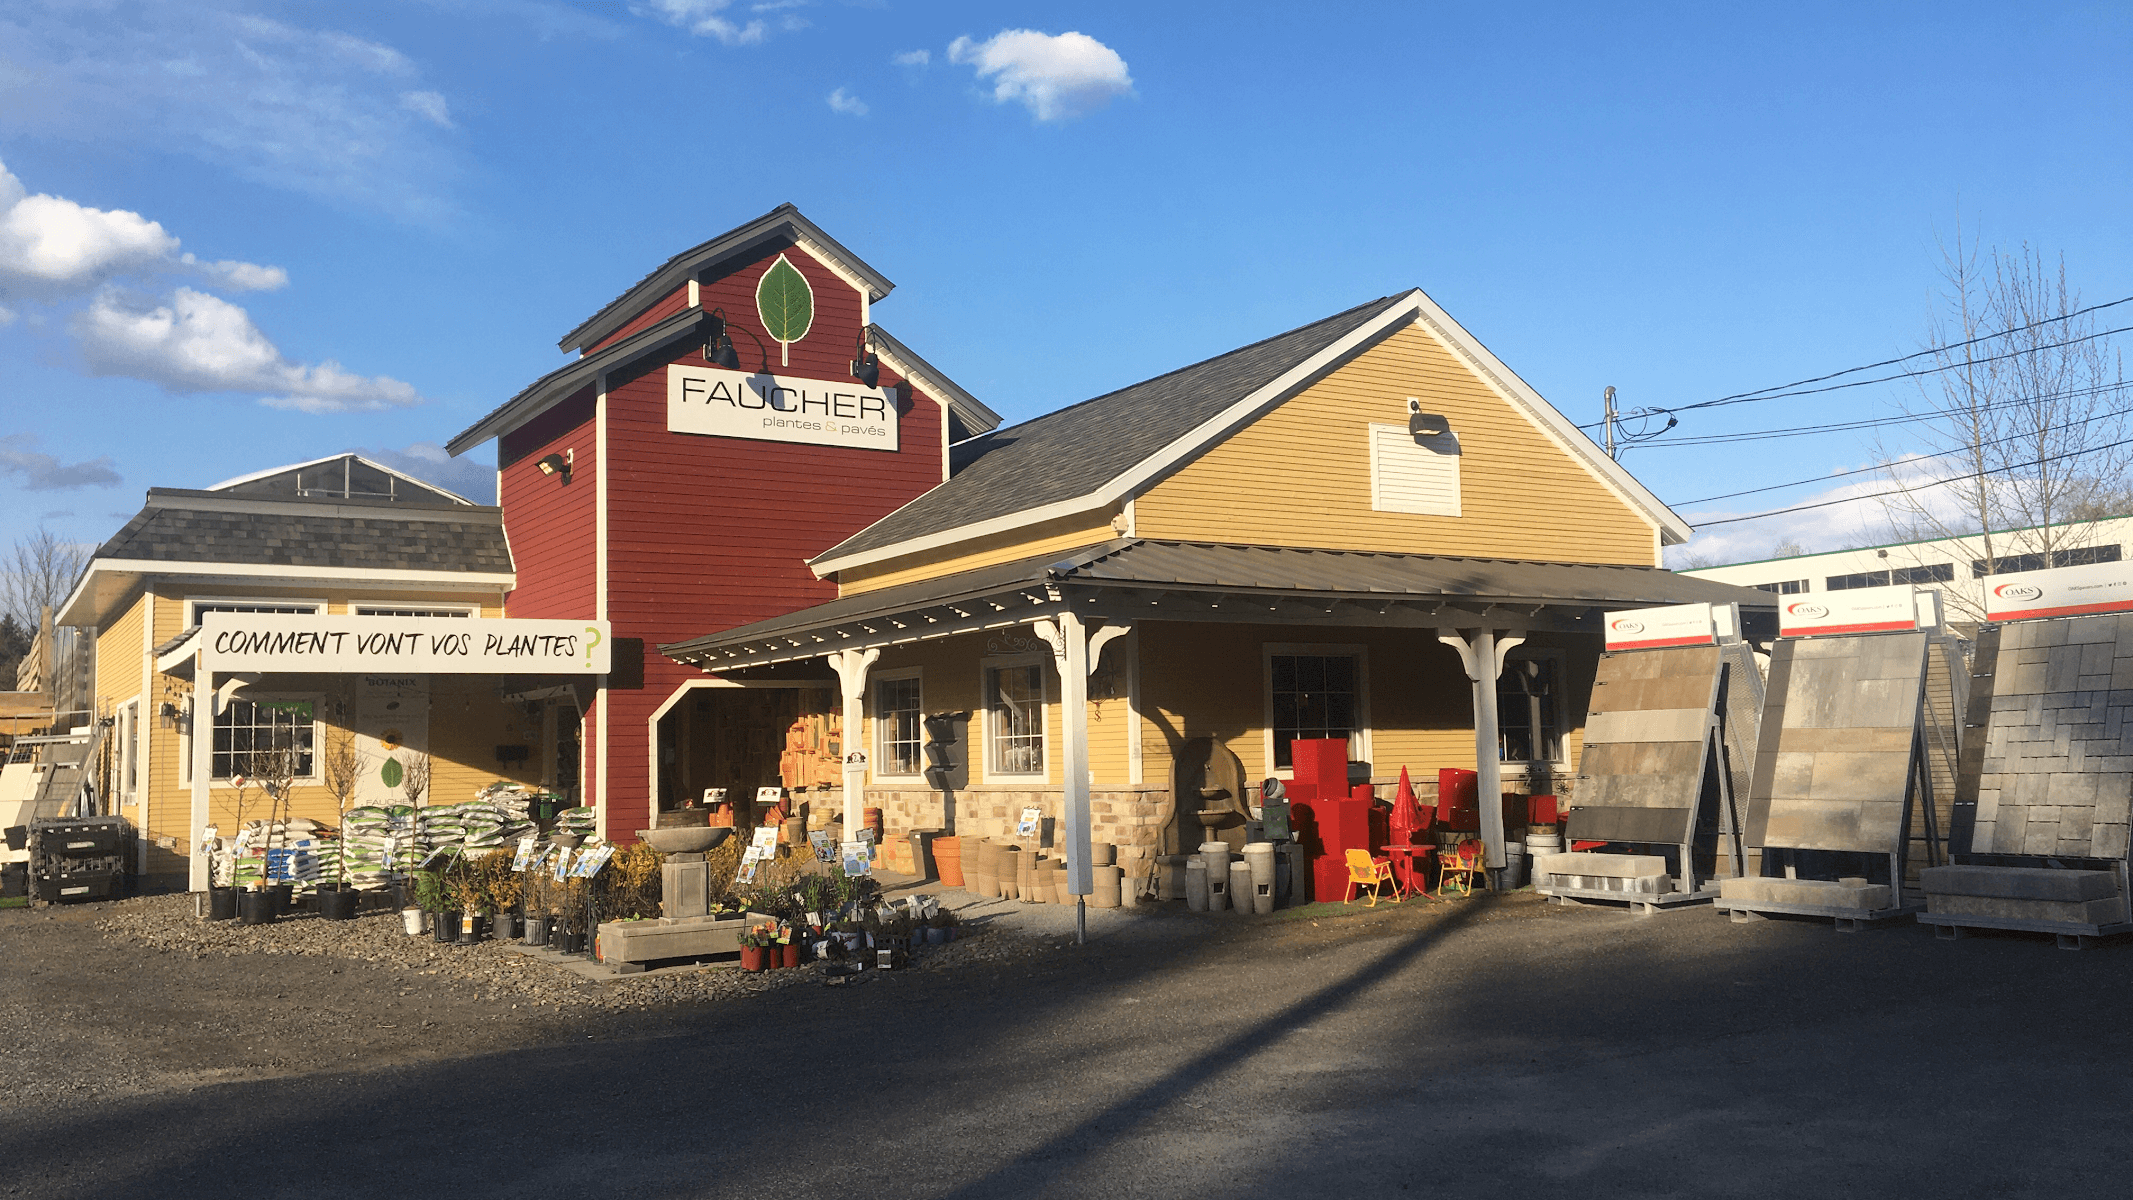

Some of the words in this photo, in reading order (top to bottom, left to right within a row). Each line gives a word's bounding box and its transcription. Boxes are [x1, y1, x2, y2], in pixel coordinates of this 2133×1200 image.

[682, 377, 886, 421] FAUCHER
[762, 416, 822, 431] plantes
[824, 421, 838, 432] &
[841, 424, 886, 437] pavés
[2005, 587, 2034, 596] OAKS
[1797, 606, 1822, 614] OAKS
[214, 630, 351, 655] COMMENT
[357, 632, 425, 656] VONT
[431, 633, 471, 656] VOS
[368, 678, 417, 687] BOTANIX
[365, 798, 415, 806] FAUCHE
